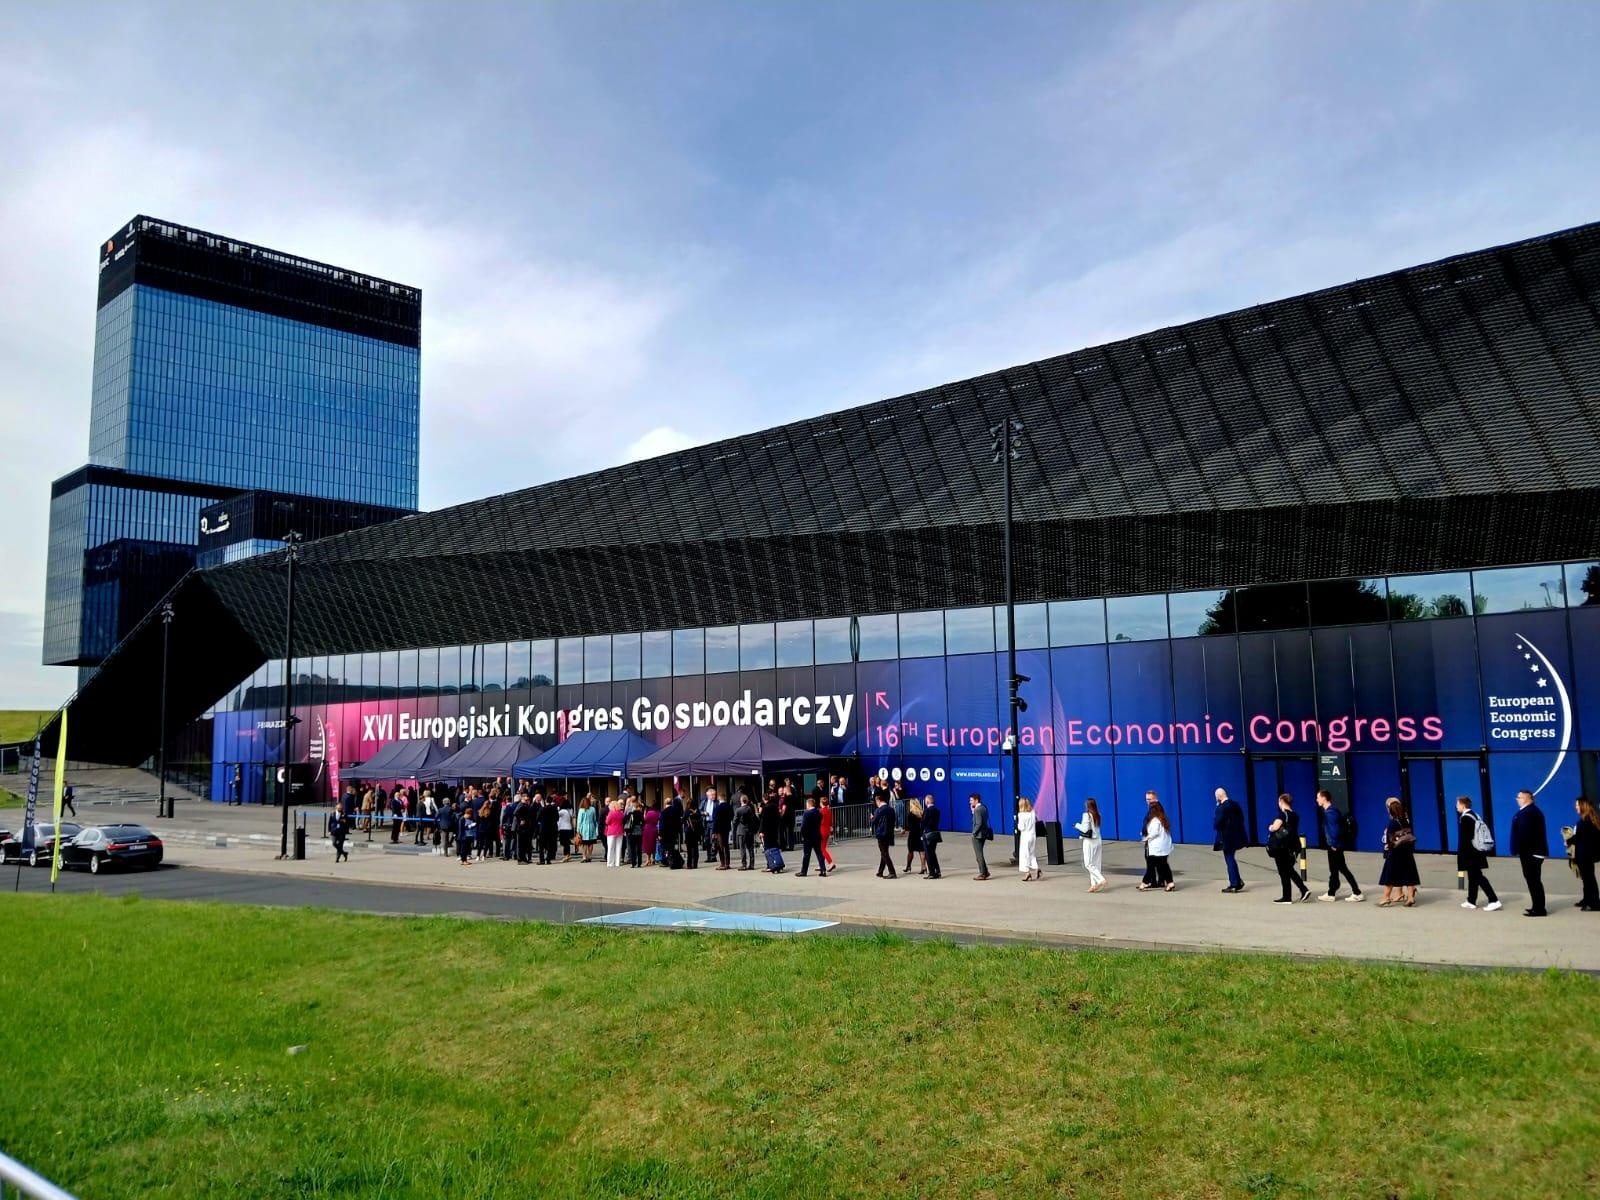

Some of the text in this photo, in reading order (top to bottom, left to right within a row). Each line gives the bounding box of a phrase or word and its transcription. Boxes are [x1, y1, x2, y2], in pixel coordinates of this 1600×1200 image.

[1488, 697, 1555, 708] European
[362, 690, 854, 748] XVI Europejski Kongres Gospodarczy
[1490, 710, 1556, 722] Economic
[1068, 715, 1235, 745] Economic
[1250, 715, 1443, 752] Congress
[1491, 728, 1555, 741] Congress
[1332, 765, 1341, 776] A
